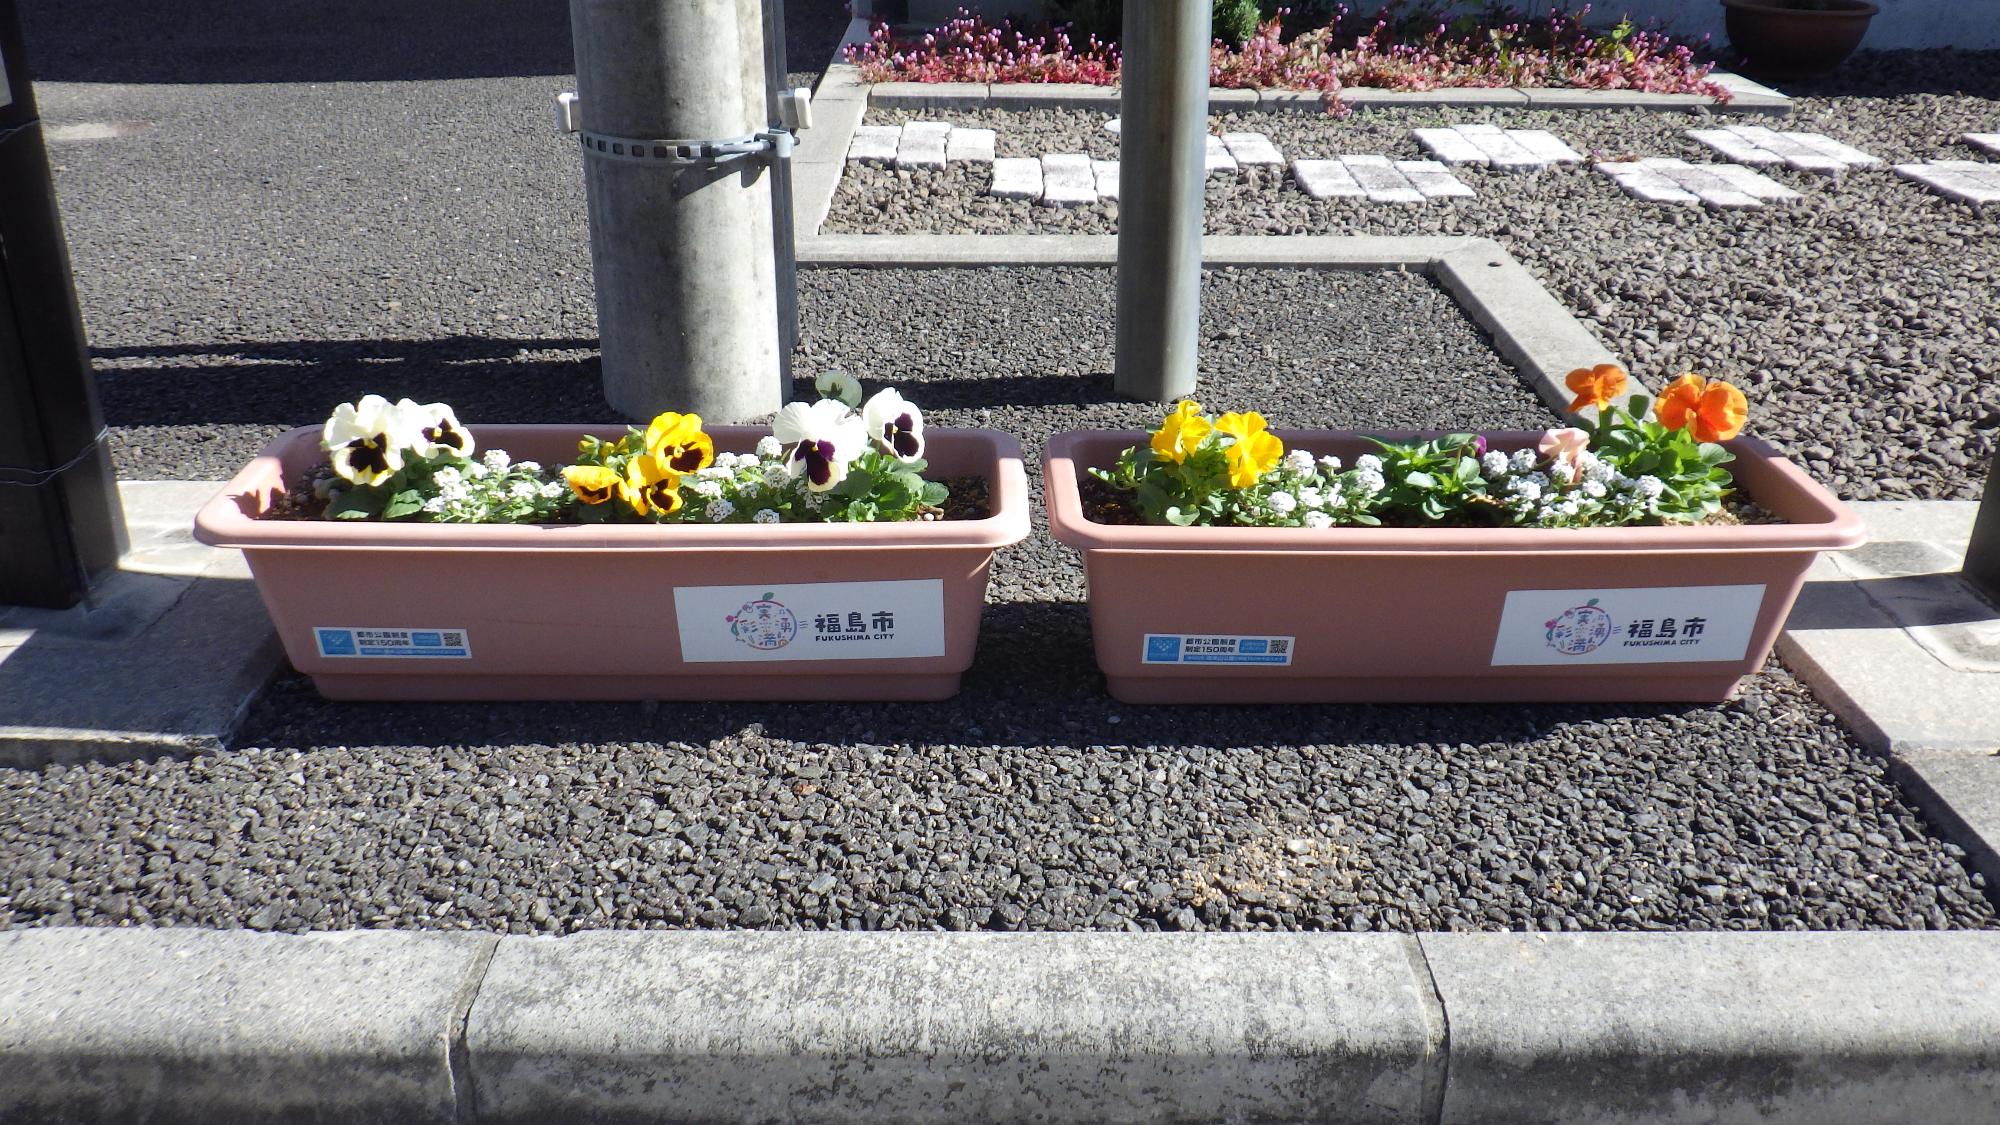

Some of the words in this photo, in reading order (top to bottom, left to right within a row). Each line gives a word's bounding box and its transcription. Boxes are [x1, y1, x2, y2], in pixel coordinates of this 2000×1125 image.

[814, 612, 894, 633] 福島市
[1627, 617, 1707, 638] 福島市
[815, 634, 871, 642] FUKUSHIMA
[1623, 639, 1677, 647] FUKUSHIMA
